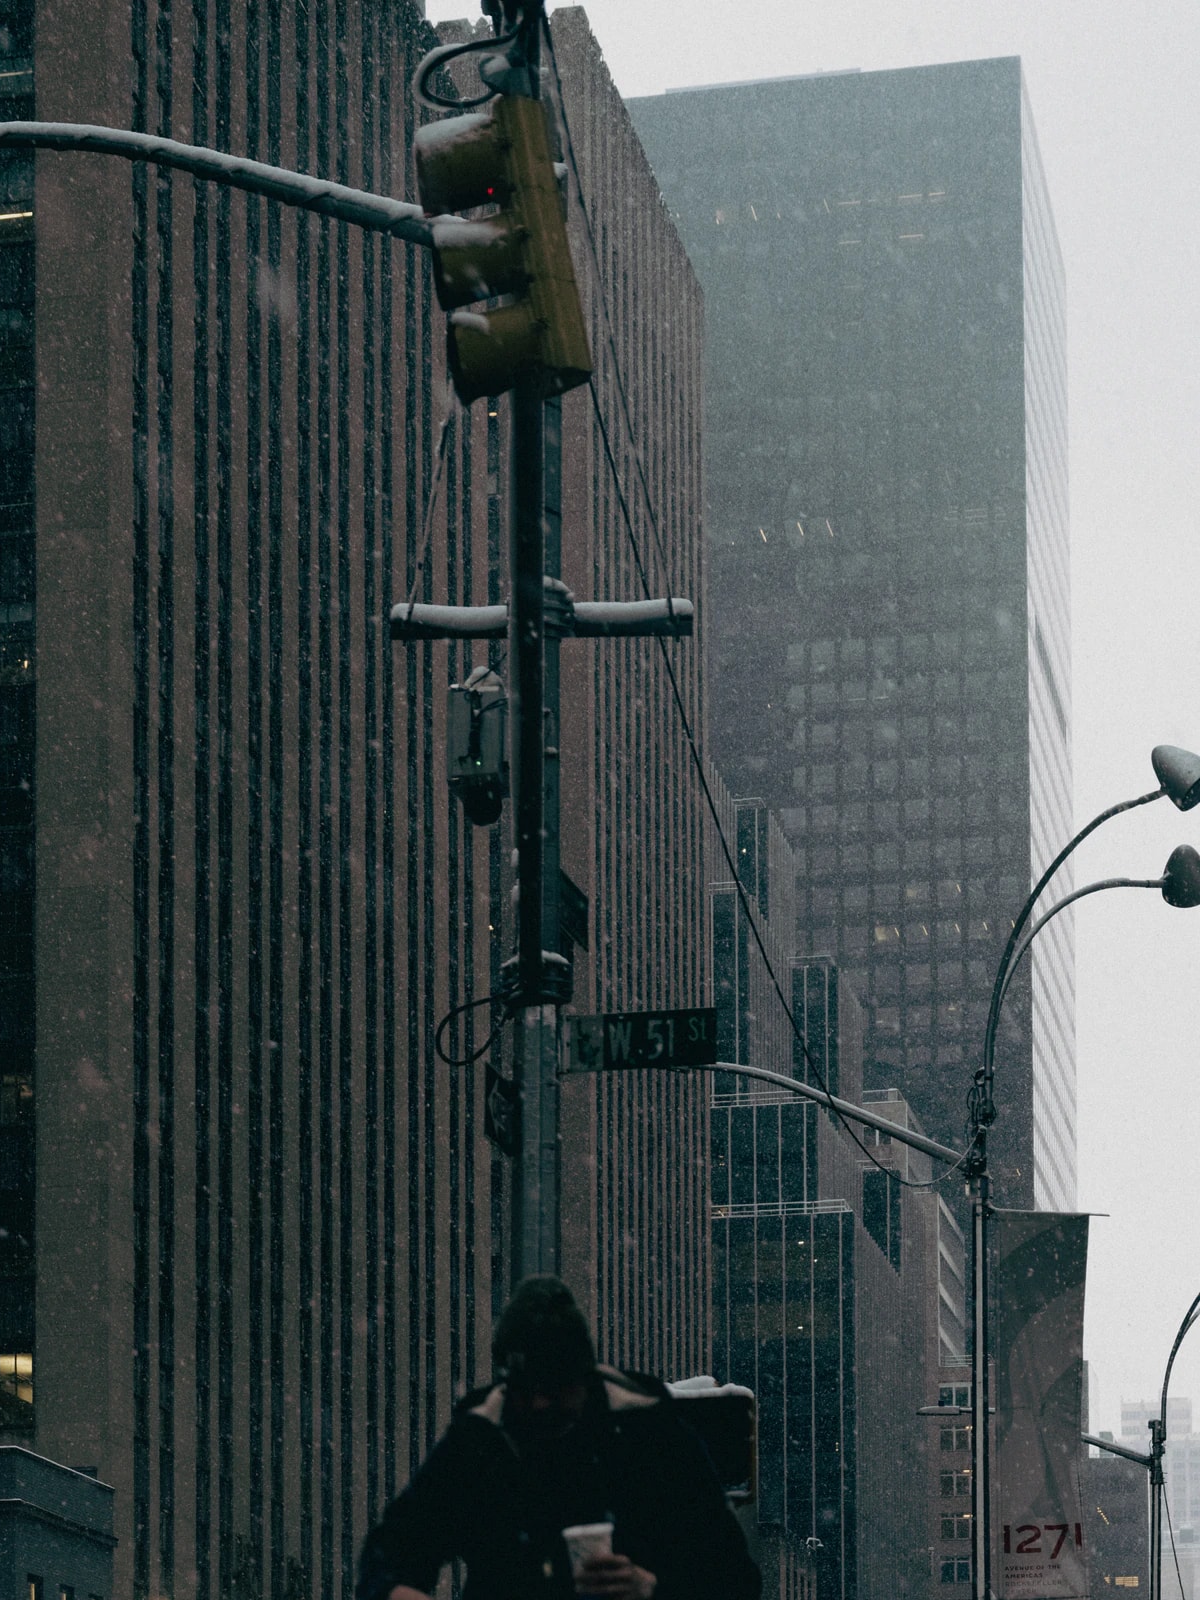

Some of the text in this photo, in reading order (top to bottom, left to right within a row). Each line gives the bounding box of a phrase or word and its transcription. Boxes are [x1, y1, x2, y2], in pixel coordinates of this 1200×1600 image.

[647, 1017, 676, 1061] 51
[687, 1015, 708, 1043] St
[1003, 1522, 1083, 1560] 1271
